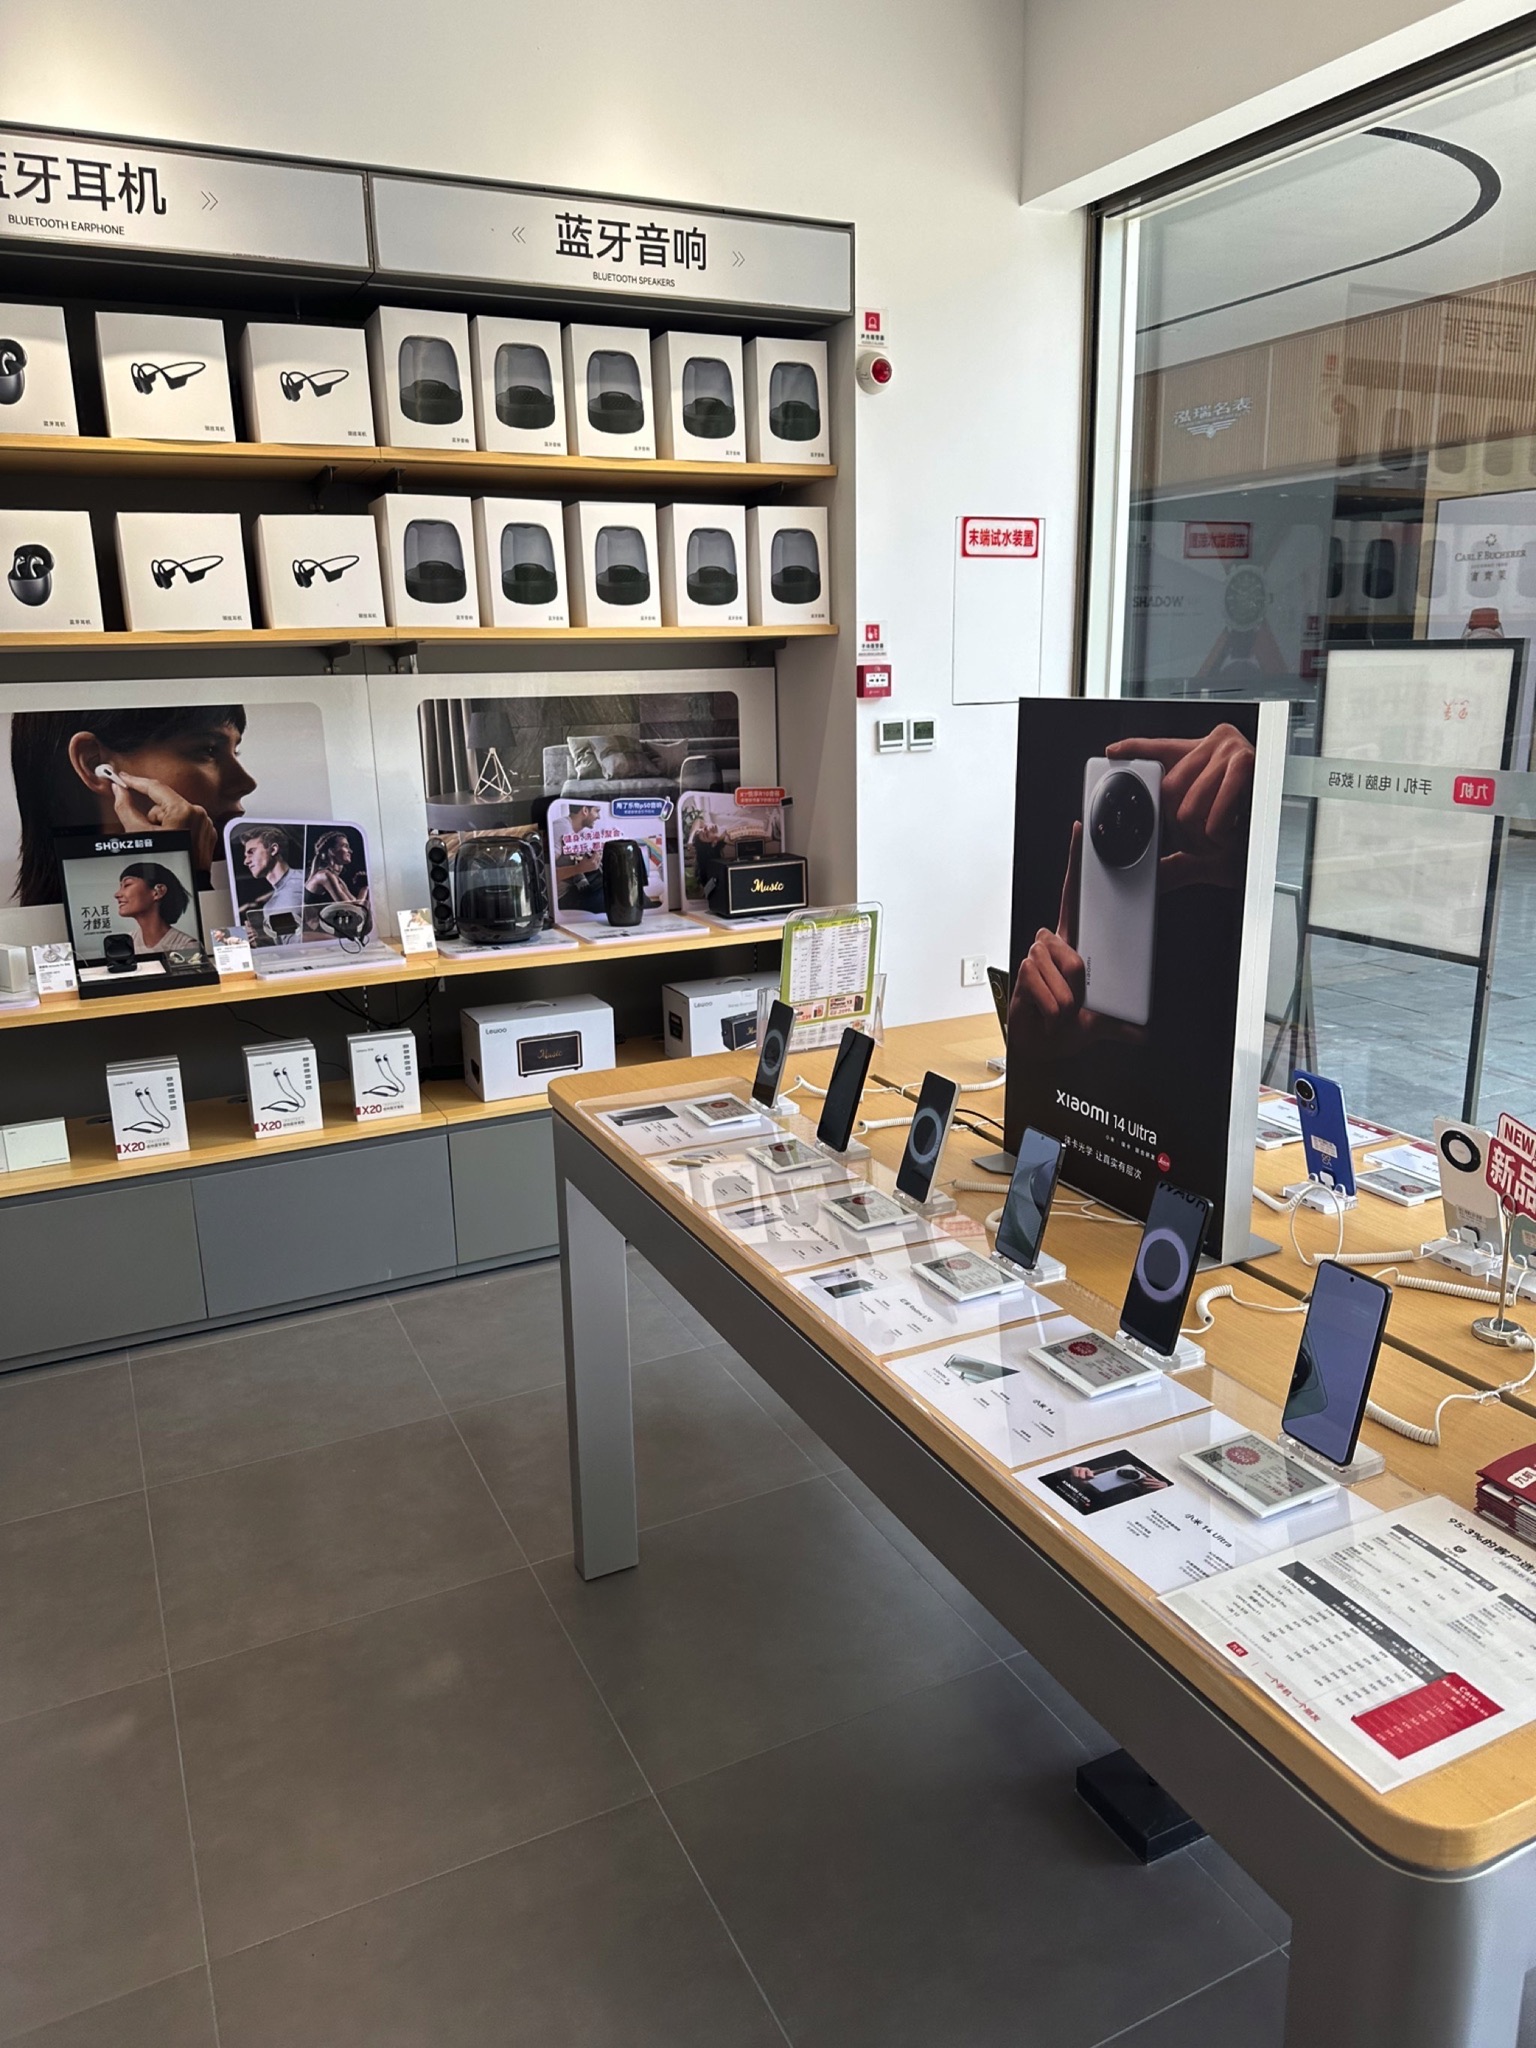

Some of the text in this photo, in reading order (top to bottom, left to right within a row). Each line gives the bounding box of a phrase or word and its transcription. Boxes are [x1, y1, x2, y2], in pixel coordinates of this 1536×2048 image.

[0, 152, 166, 215] 牙耳机
[8, 214, 125, 235] BLUETOOTH EARPHONE
[555, 212, 707, 271] 蓝牙音响
[592, 271, 676, 288] BLUETOOTH SPEAKERS
[43, 420, 67, 428] 蓝牙耳机
[968, 528, 1034, 549] 末端试水装置
[1455, 552, 1476, 562] CARL
[1484, 549, 1526, 560] BUCHERER
[69, 618, 91, 626] 蓝牙耳机
[95, 840, 134, 851] SHOKZ
[750, 878, 785, 894] Music
[81, 904, 110, 918] 不入耳
[83, 917, 111, 930] 才舒适
[362, 1104, 382, 1115] X20
[261, 1120, 282, 1132] X20
[1113, 1114, 1125, 1132] 14
[1127, 1120, 1157, 1146] Ultra
[123, 1141, 145, 1153] X20
[1063, 1134, 1143, 1182] 徕卡光学 让真实有层次
[1490, 1145, 1536, 1214] 新品
[1514, 1470, 1536, 1485] 九机
[1184, 1513, 1235, 1547] 小米 14 Ultra
[1303, 1575, 1316, 1584] 机型
[1263, 1671, 1292, 1696] 一个手机
[1290, 1696, 1321, 1722] 一个朋友
